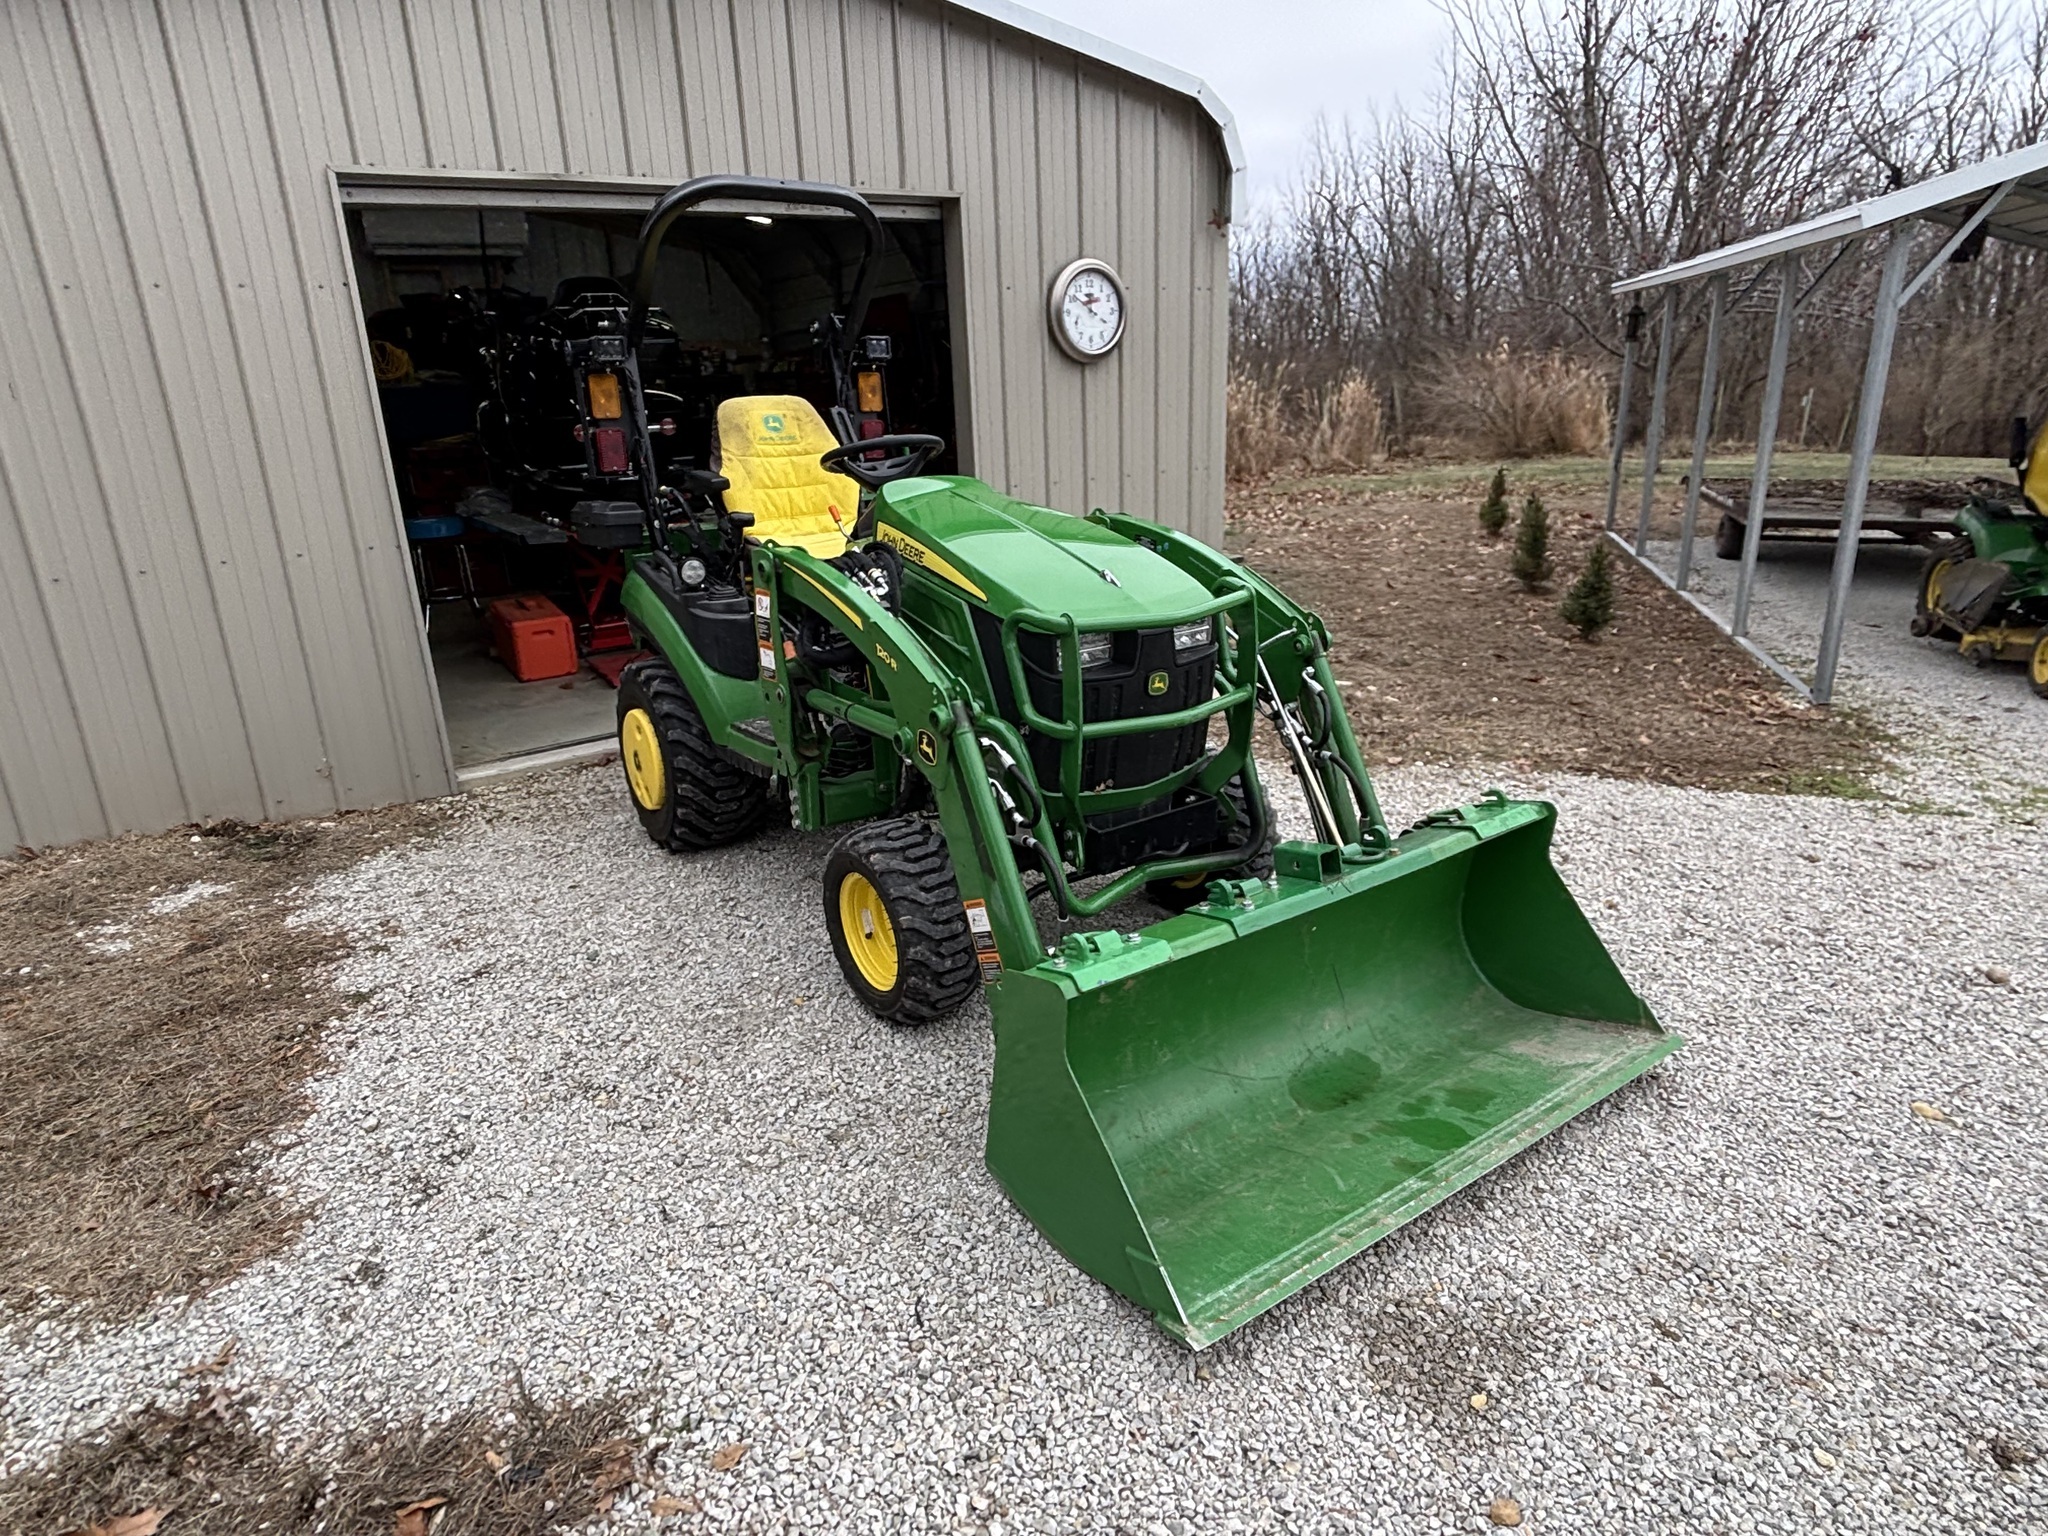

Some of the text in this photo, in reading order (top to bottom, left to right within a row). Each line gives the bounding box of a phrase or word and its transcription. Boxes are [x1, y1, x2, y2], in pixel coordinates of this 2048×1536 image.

[1085, 279, 1094, 288] 12
[1074, 284, 1083, 293] 11
[1099, 284, 1104, 293] 1
[1105, 294, 1111, 303] 2
[1065, 308, 1071, 317] 9
[1109, 307, 1115, 316] 3
[1078, 332, 1084, 340] 7
[898, 537, 926, 564] DEERE
